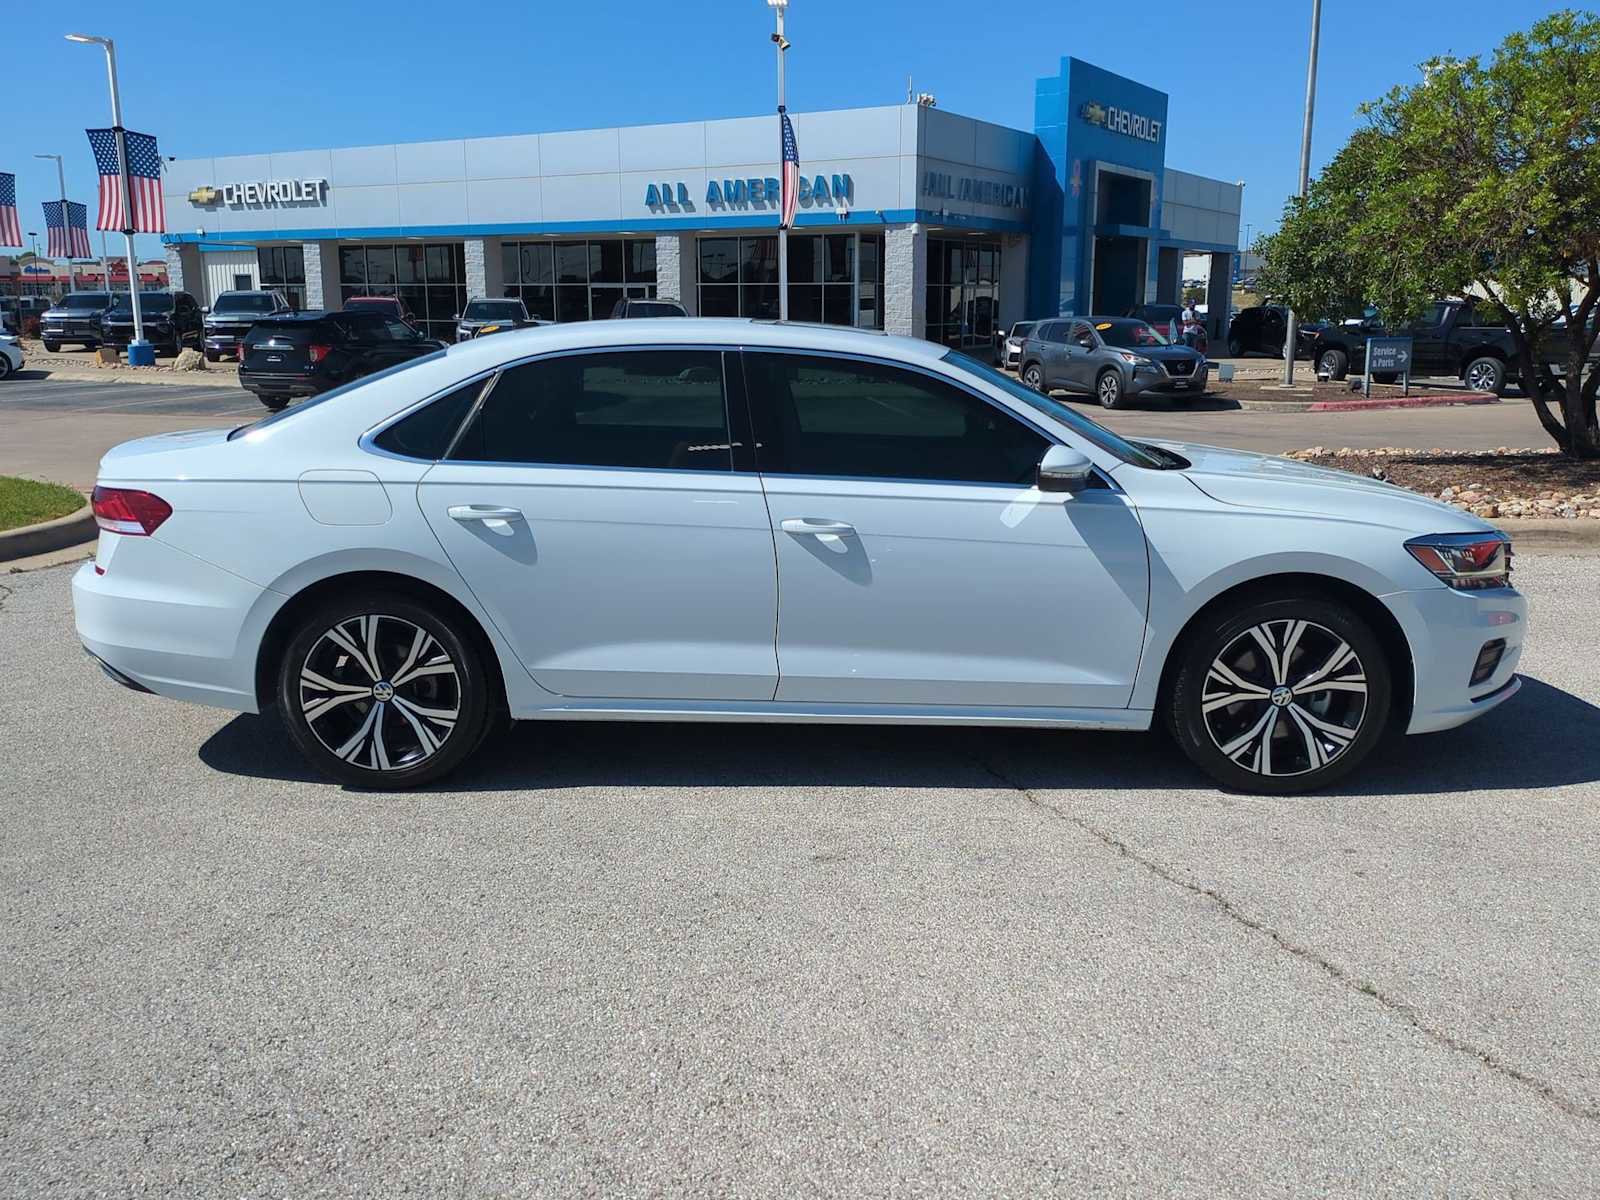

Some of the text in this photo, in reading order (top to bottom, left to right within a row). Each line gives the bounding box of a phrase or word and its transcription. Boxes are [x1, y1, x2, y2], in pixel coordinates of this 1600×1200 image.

[1107, 106, 1161, 143] CHEVROLET
[223, 179, 323, 204] CHEVROLET
[644, 174, 850, 207] ALL AMERCAN
[1373, 346, 1397, 356] Service
[1378, 358, 1395, 368] Parts
